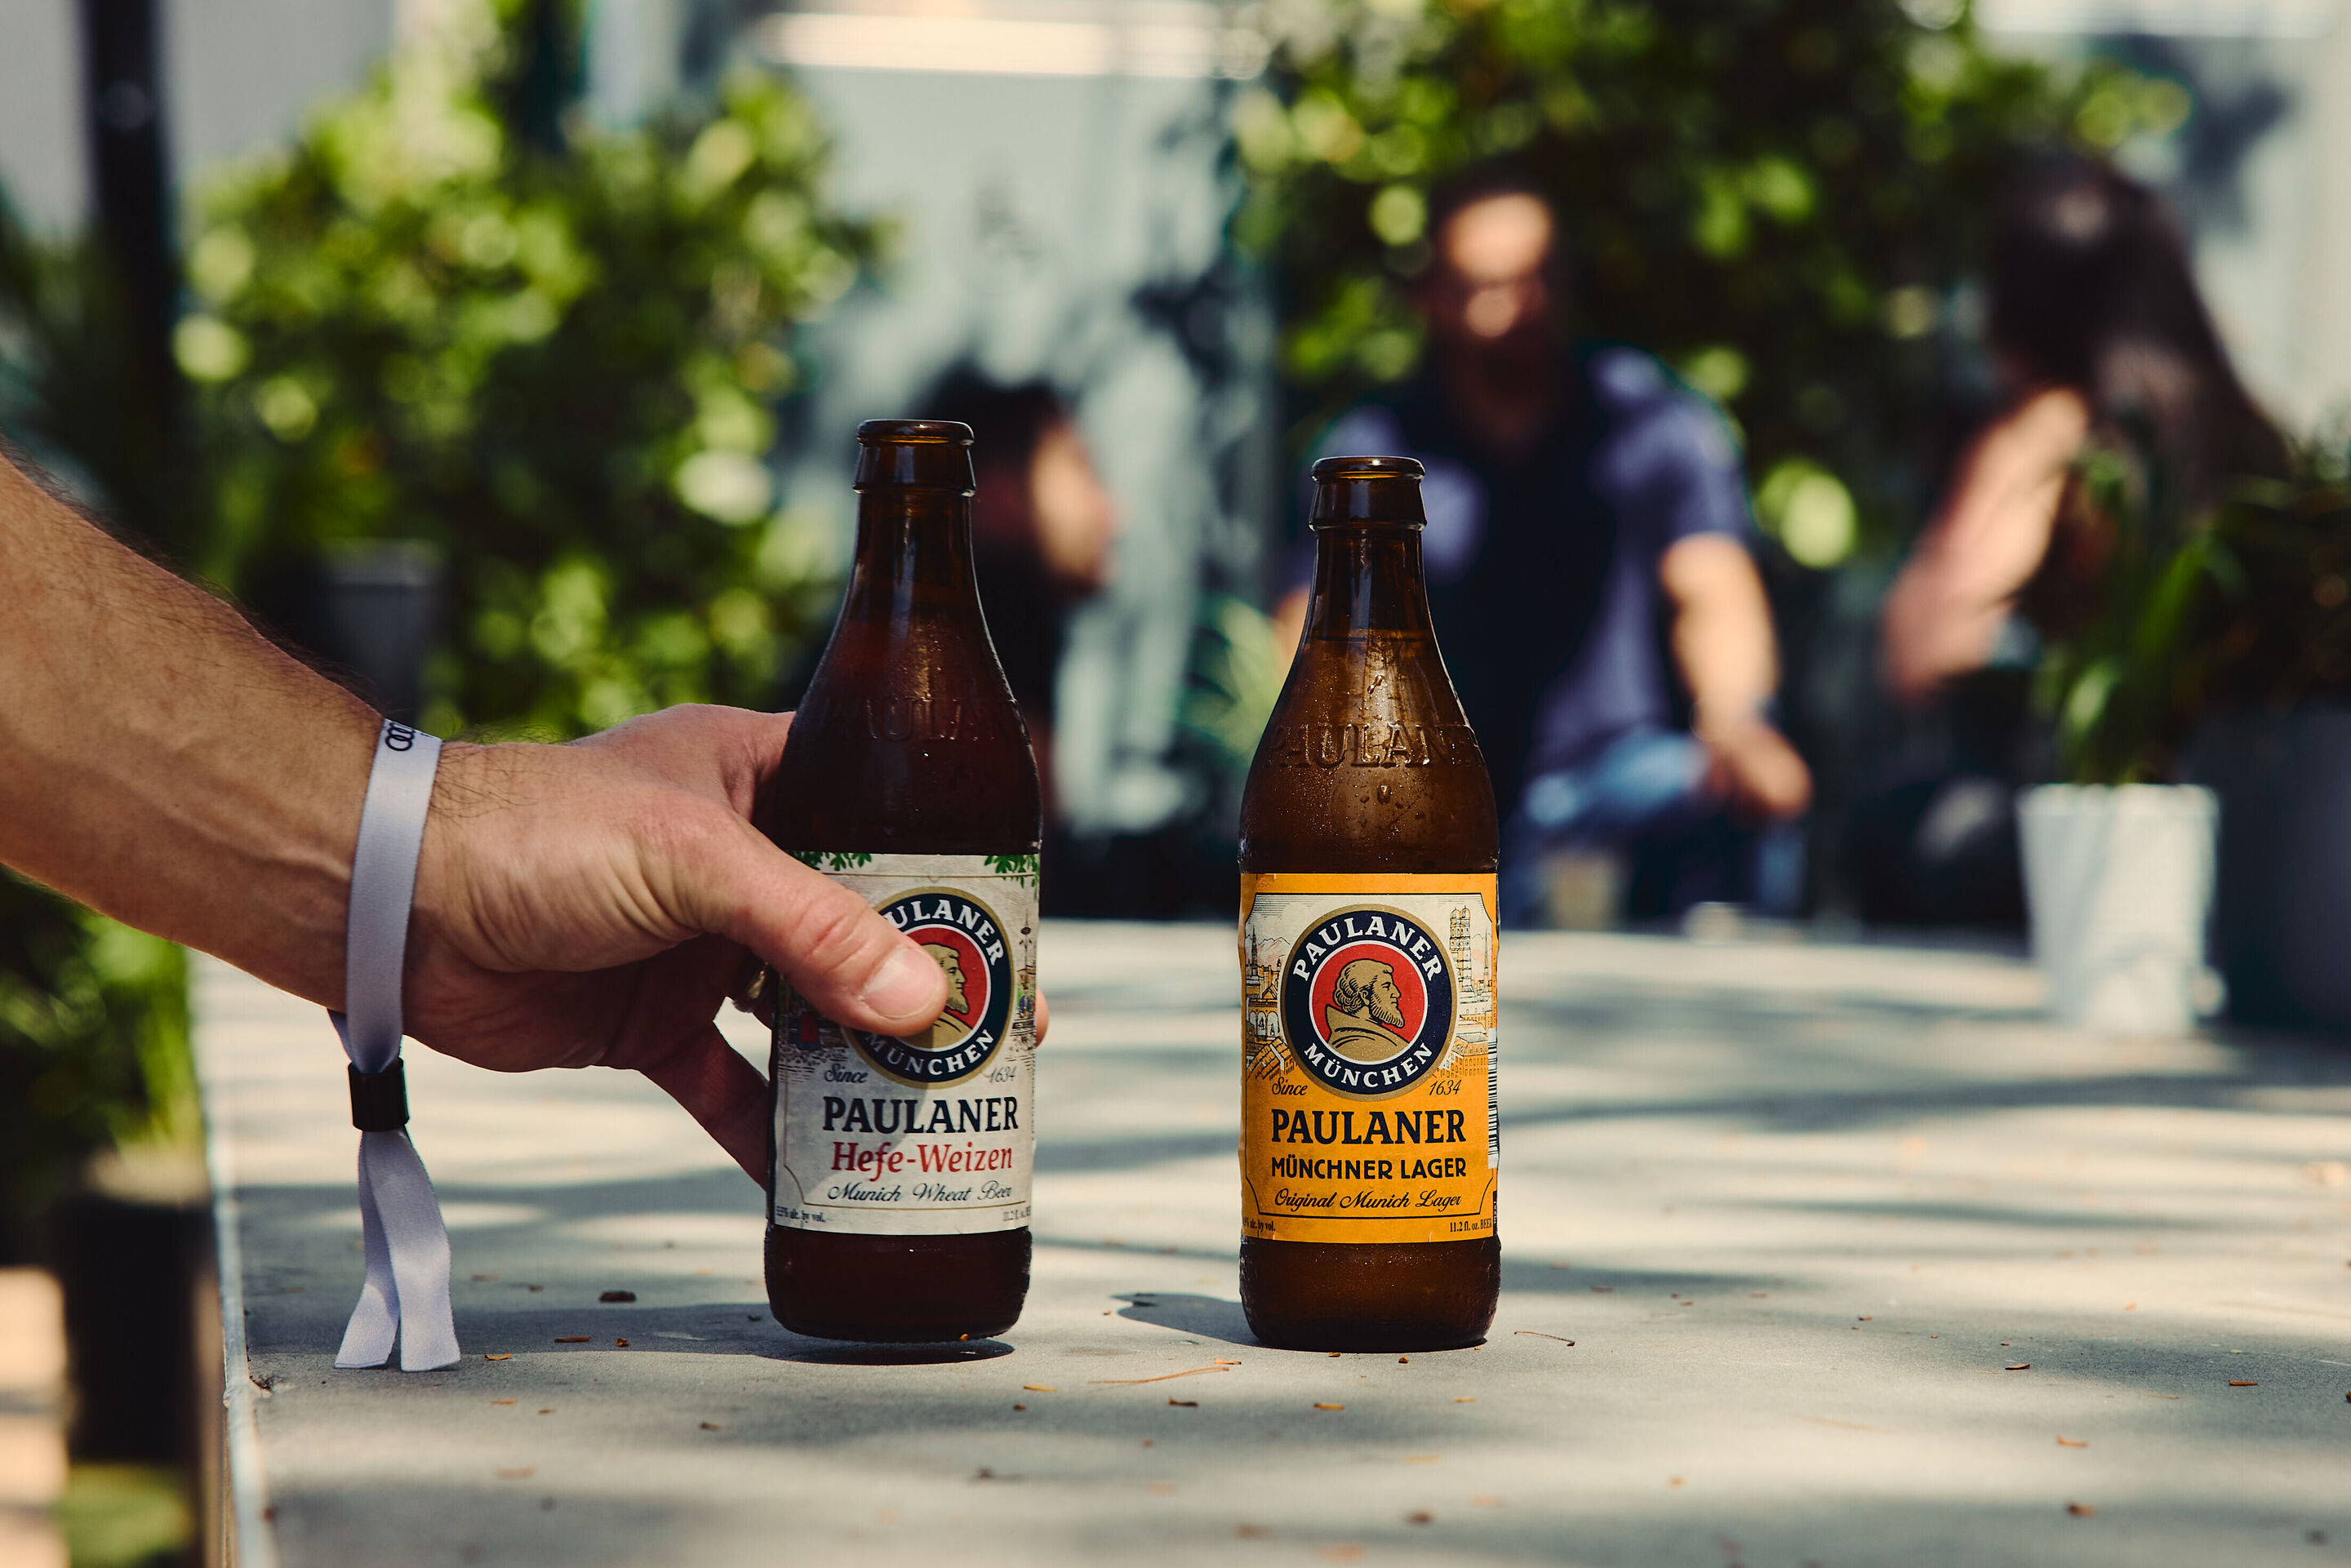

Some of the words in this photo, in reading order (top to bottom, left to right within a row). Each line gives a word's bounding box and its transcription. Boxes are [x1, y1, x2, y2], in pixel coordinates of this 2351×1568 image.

[884, 899, 1004, 966] ULANER
[1293, 916, 1442, 981] PAULANER
[865, 1029, 994, 1076] MÜNCHEN
[1304, 1042, 1433, 1088] MÜNCHEN
[824, 1064, 869, 1083] Since
[989, 1066, 1016, 1083] 1634
[1272, 1077, 1308, 1095] Since
[1429, 1079, 1461, 1095] 1634
[823, 1096, 1018, 1134] PAULANER
[1271, 1108, 1466, 1144] PAULANER
[831, 1142, 1012, 1182] Hefe-Weizen
[1271, 1154, 1393, 1179] MÜNCHNER
[1401, 1157, 1466, 1179] LAGER
[827, 1182, 901, 1202] Munich
[913, 1184, 971, 1202] Wheat
[977, 1180, 1012, 1200] Beer
[1274, 1188, 1337, 1212] Original
[1340, 1190, 1411, 1209] Munich
[1415, 1189, 1461, 1212] Lager
[1265, 1220, 1275, 1231] vol.
[1450, 1221, 1462, 1232] 11.2
